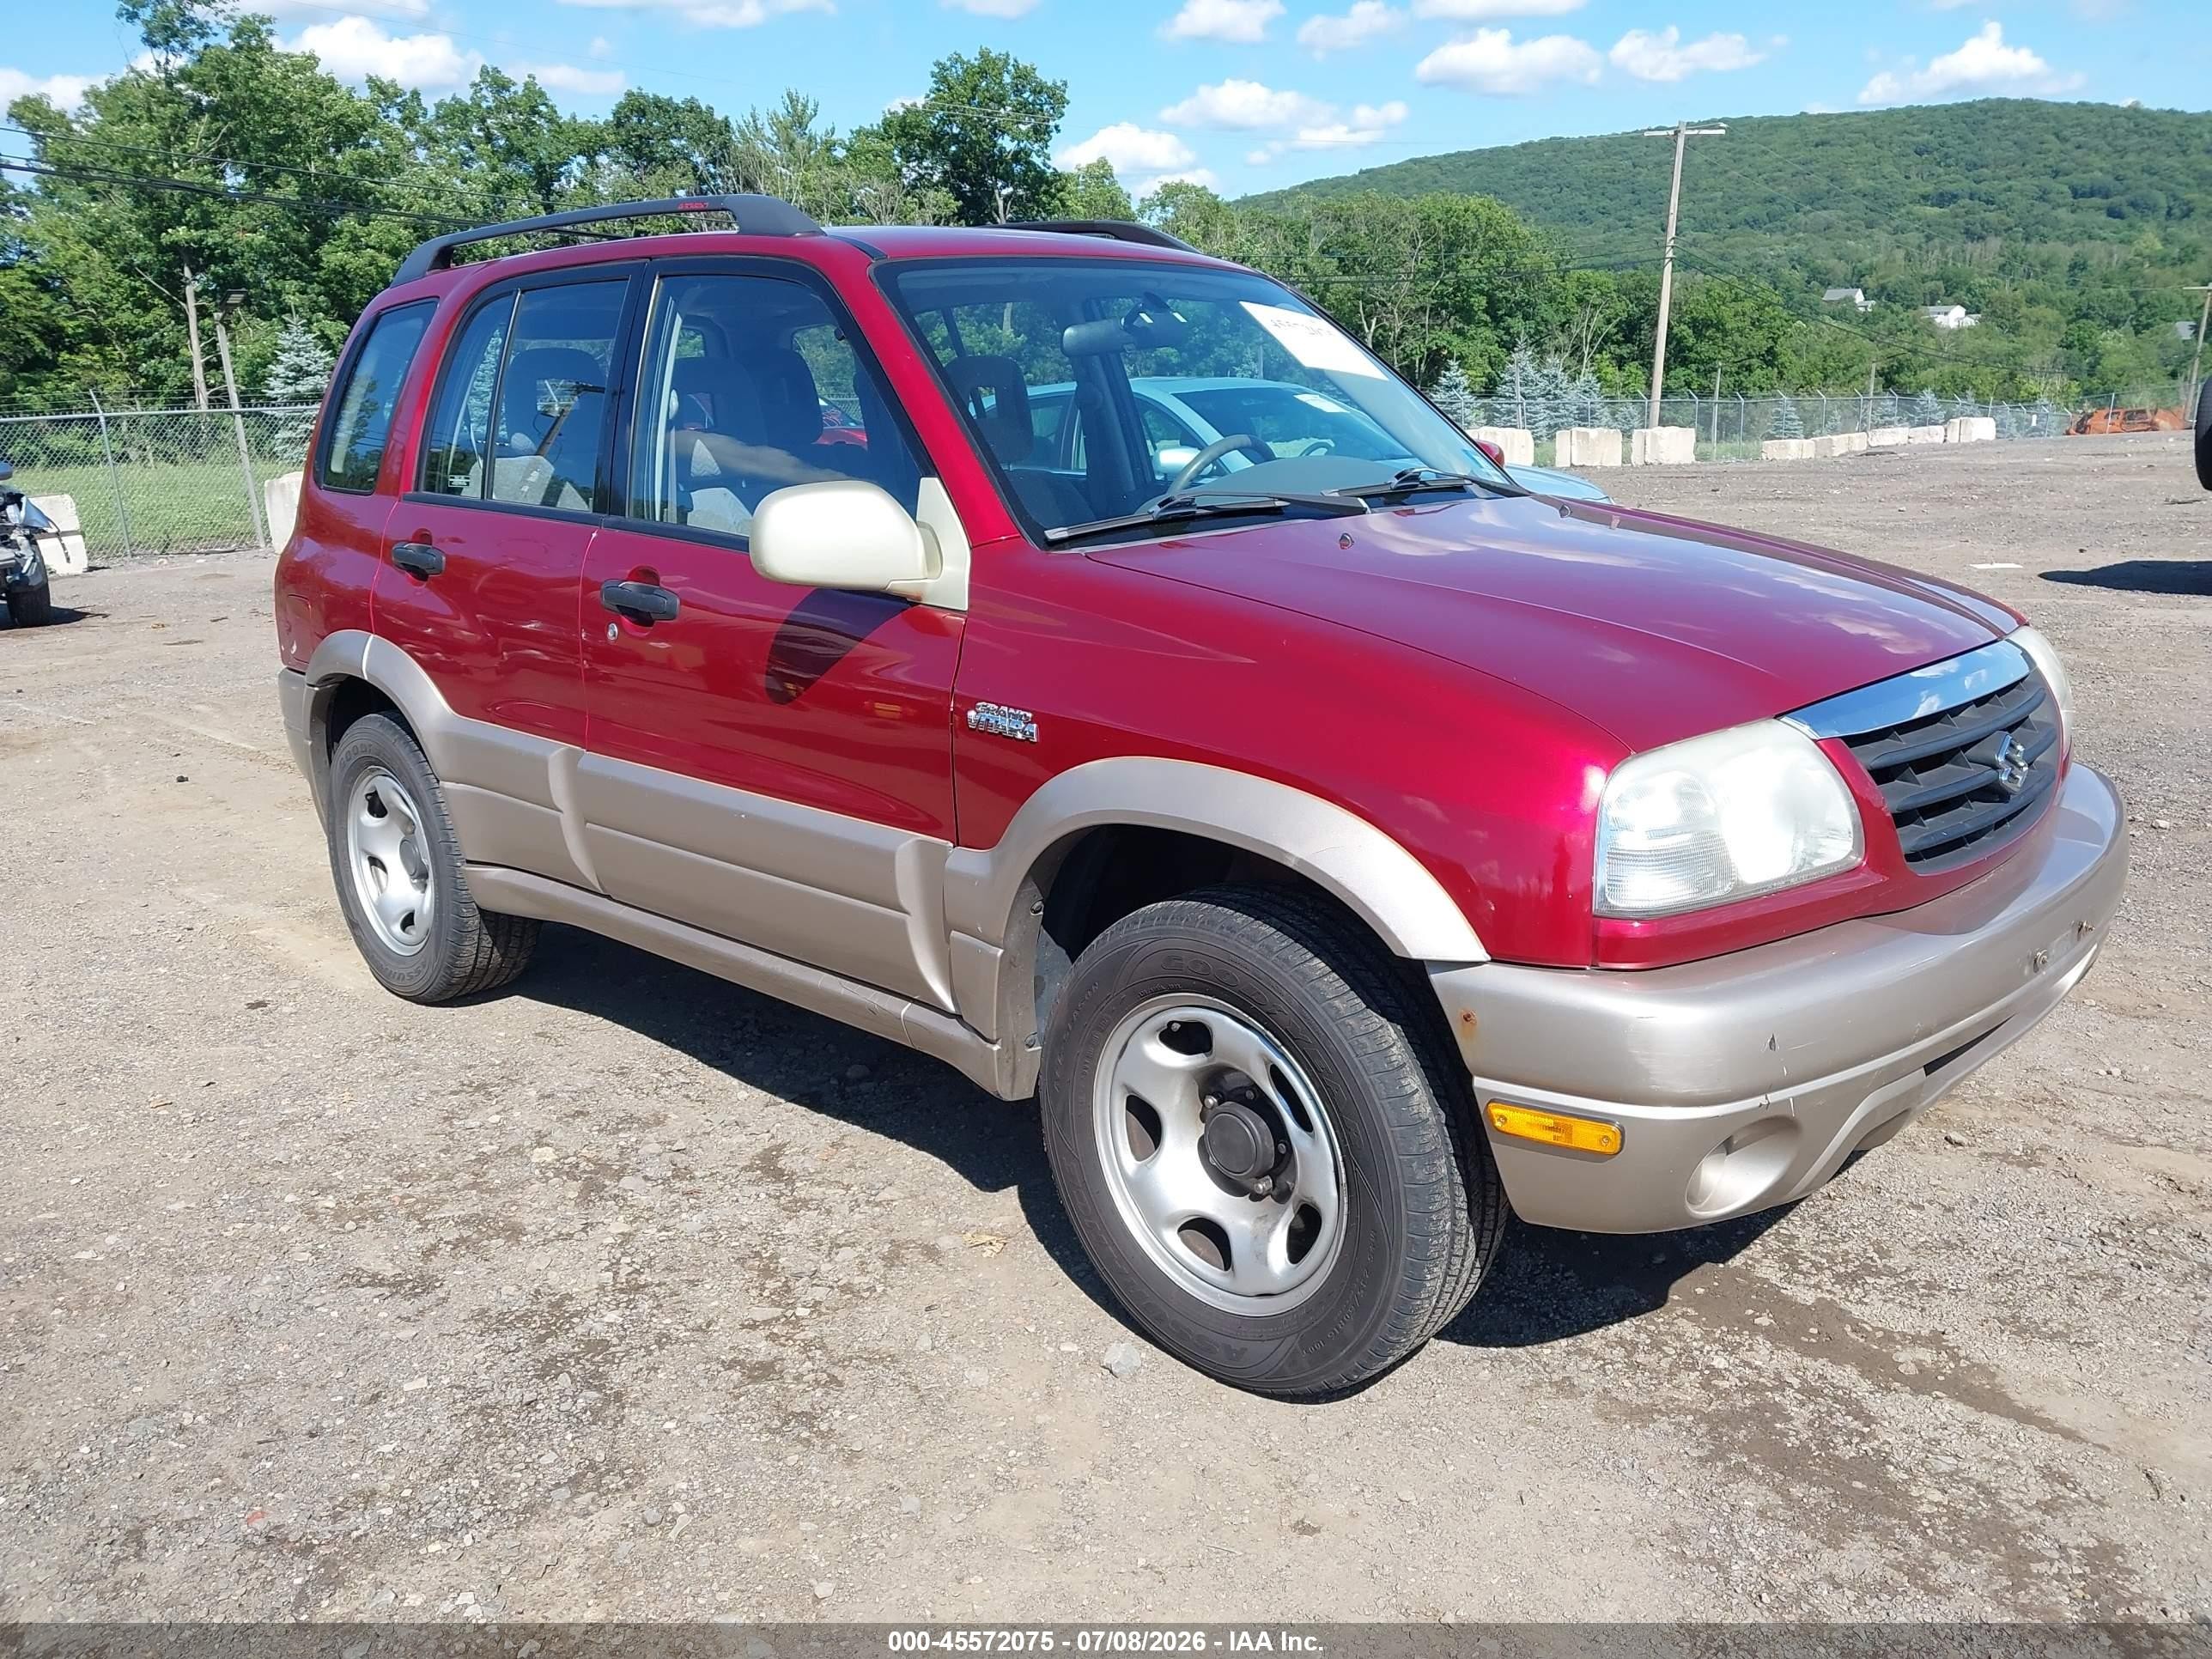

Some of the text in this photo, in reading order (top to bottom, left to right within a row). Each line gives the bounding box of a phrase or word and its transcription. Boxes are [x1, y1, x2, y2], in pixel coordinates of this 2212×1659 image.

[968, 710, 1038, 742] VITARA
[975, 702, 1032, 723] GRAND
[1160, 955, 1365, 1153] GOODYEAR
